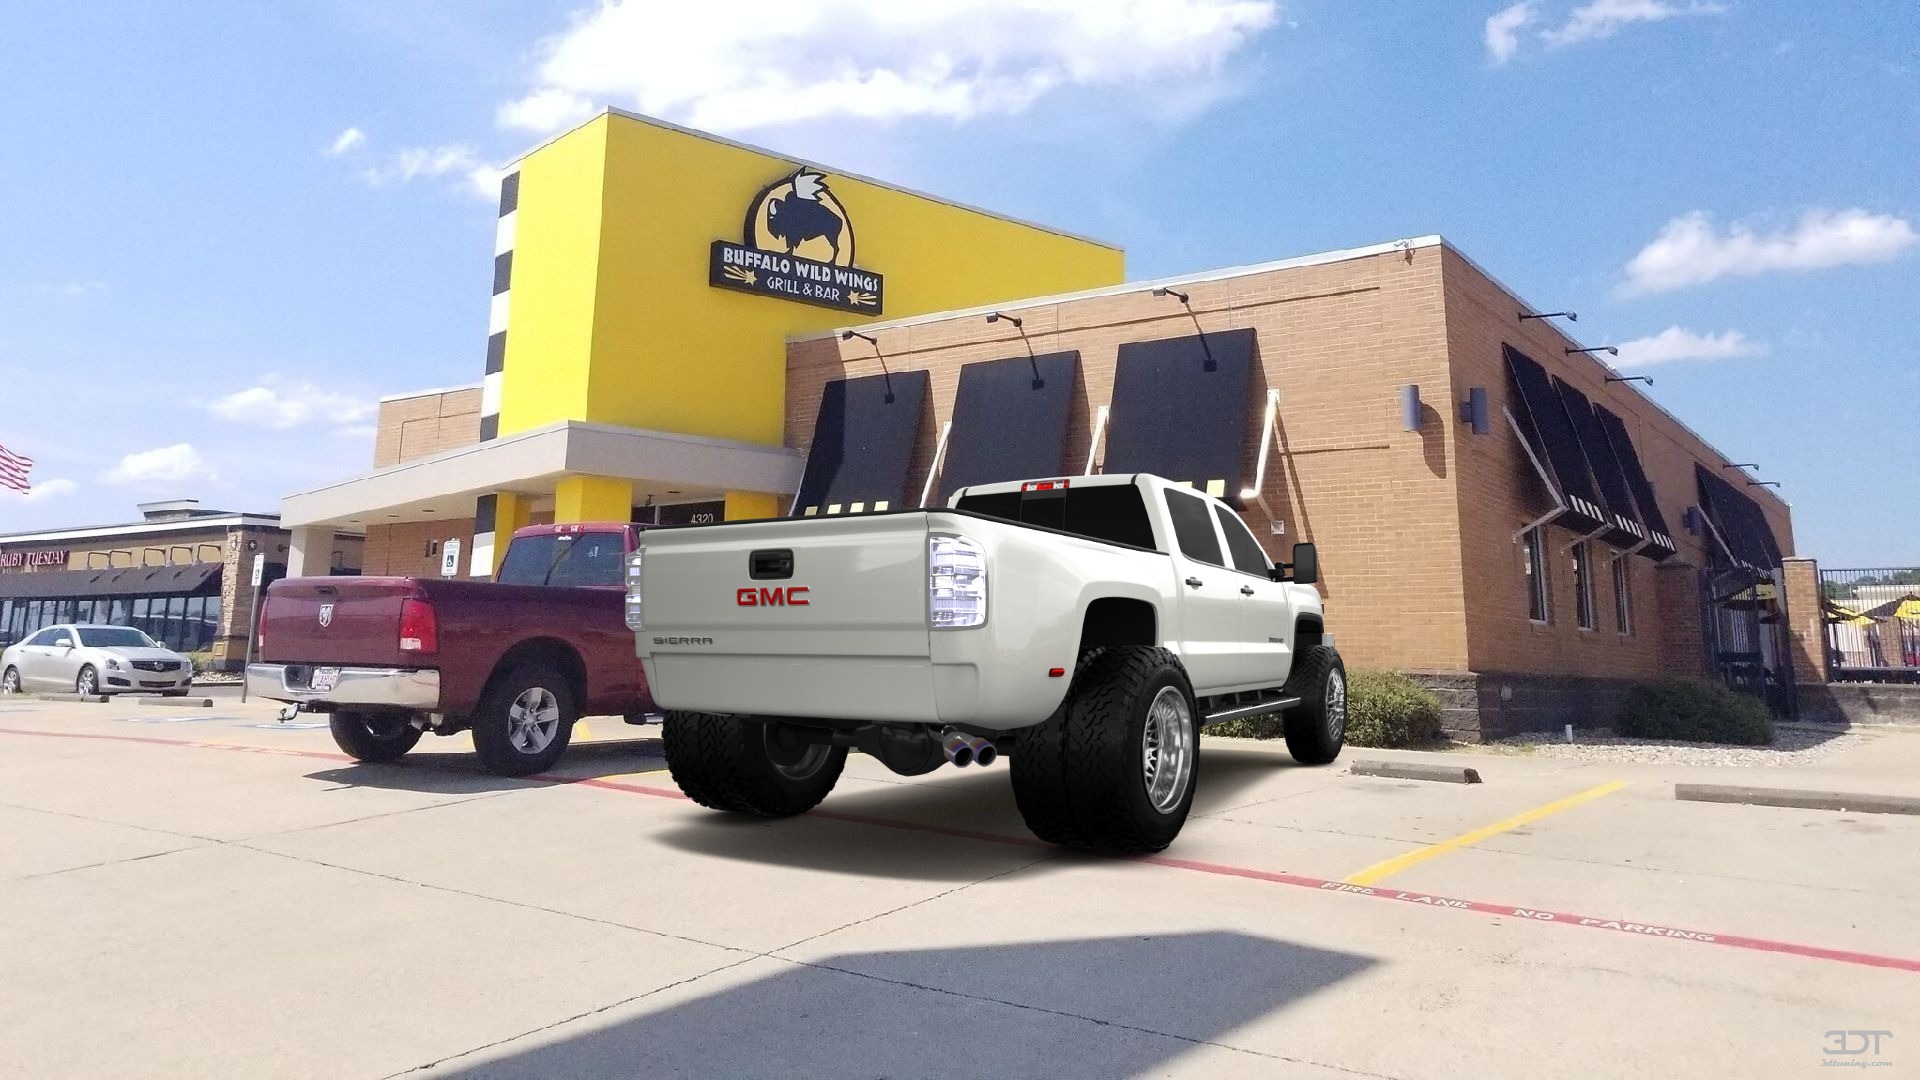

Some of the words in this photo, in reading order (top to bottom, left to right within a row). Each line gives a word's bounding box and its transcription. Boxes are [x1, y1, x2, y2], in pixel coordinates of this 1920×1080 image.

[723, 247, 790, 274] BUFFALO
[795, 261, 831, 282] WILD
[834, 269, 878, 292] WINGS
[766, 276, 799, 295] GRILL
[802, 282, 813, 296] &
[815, 285, 840, 302] BAR
[690, 513, 714, 524] 4320
[0, 553, 22, 567] RUBY
[26, 550, 65, 566] TUESDAY
[736, 586, 810, 607] GMC
[653, 636, 713, 645] SIERRA
[1319, 881, 1376, 896] FIRE
[1395, 892, 1472, 909] LANE
[1511, 908, 1555, 921] NO
[1579, 918, 1717, 943] PARKING
